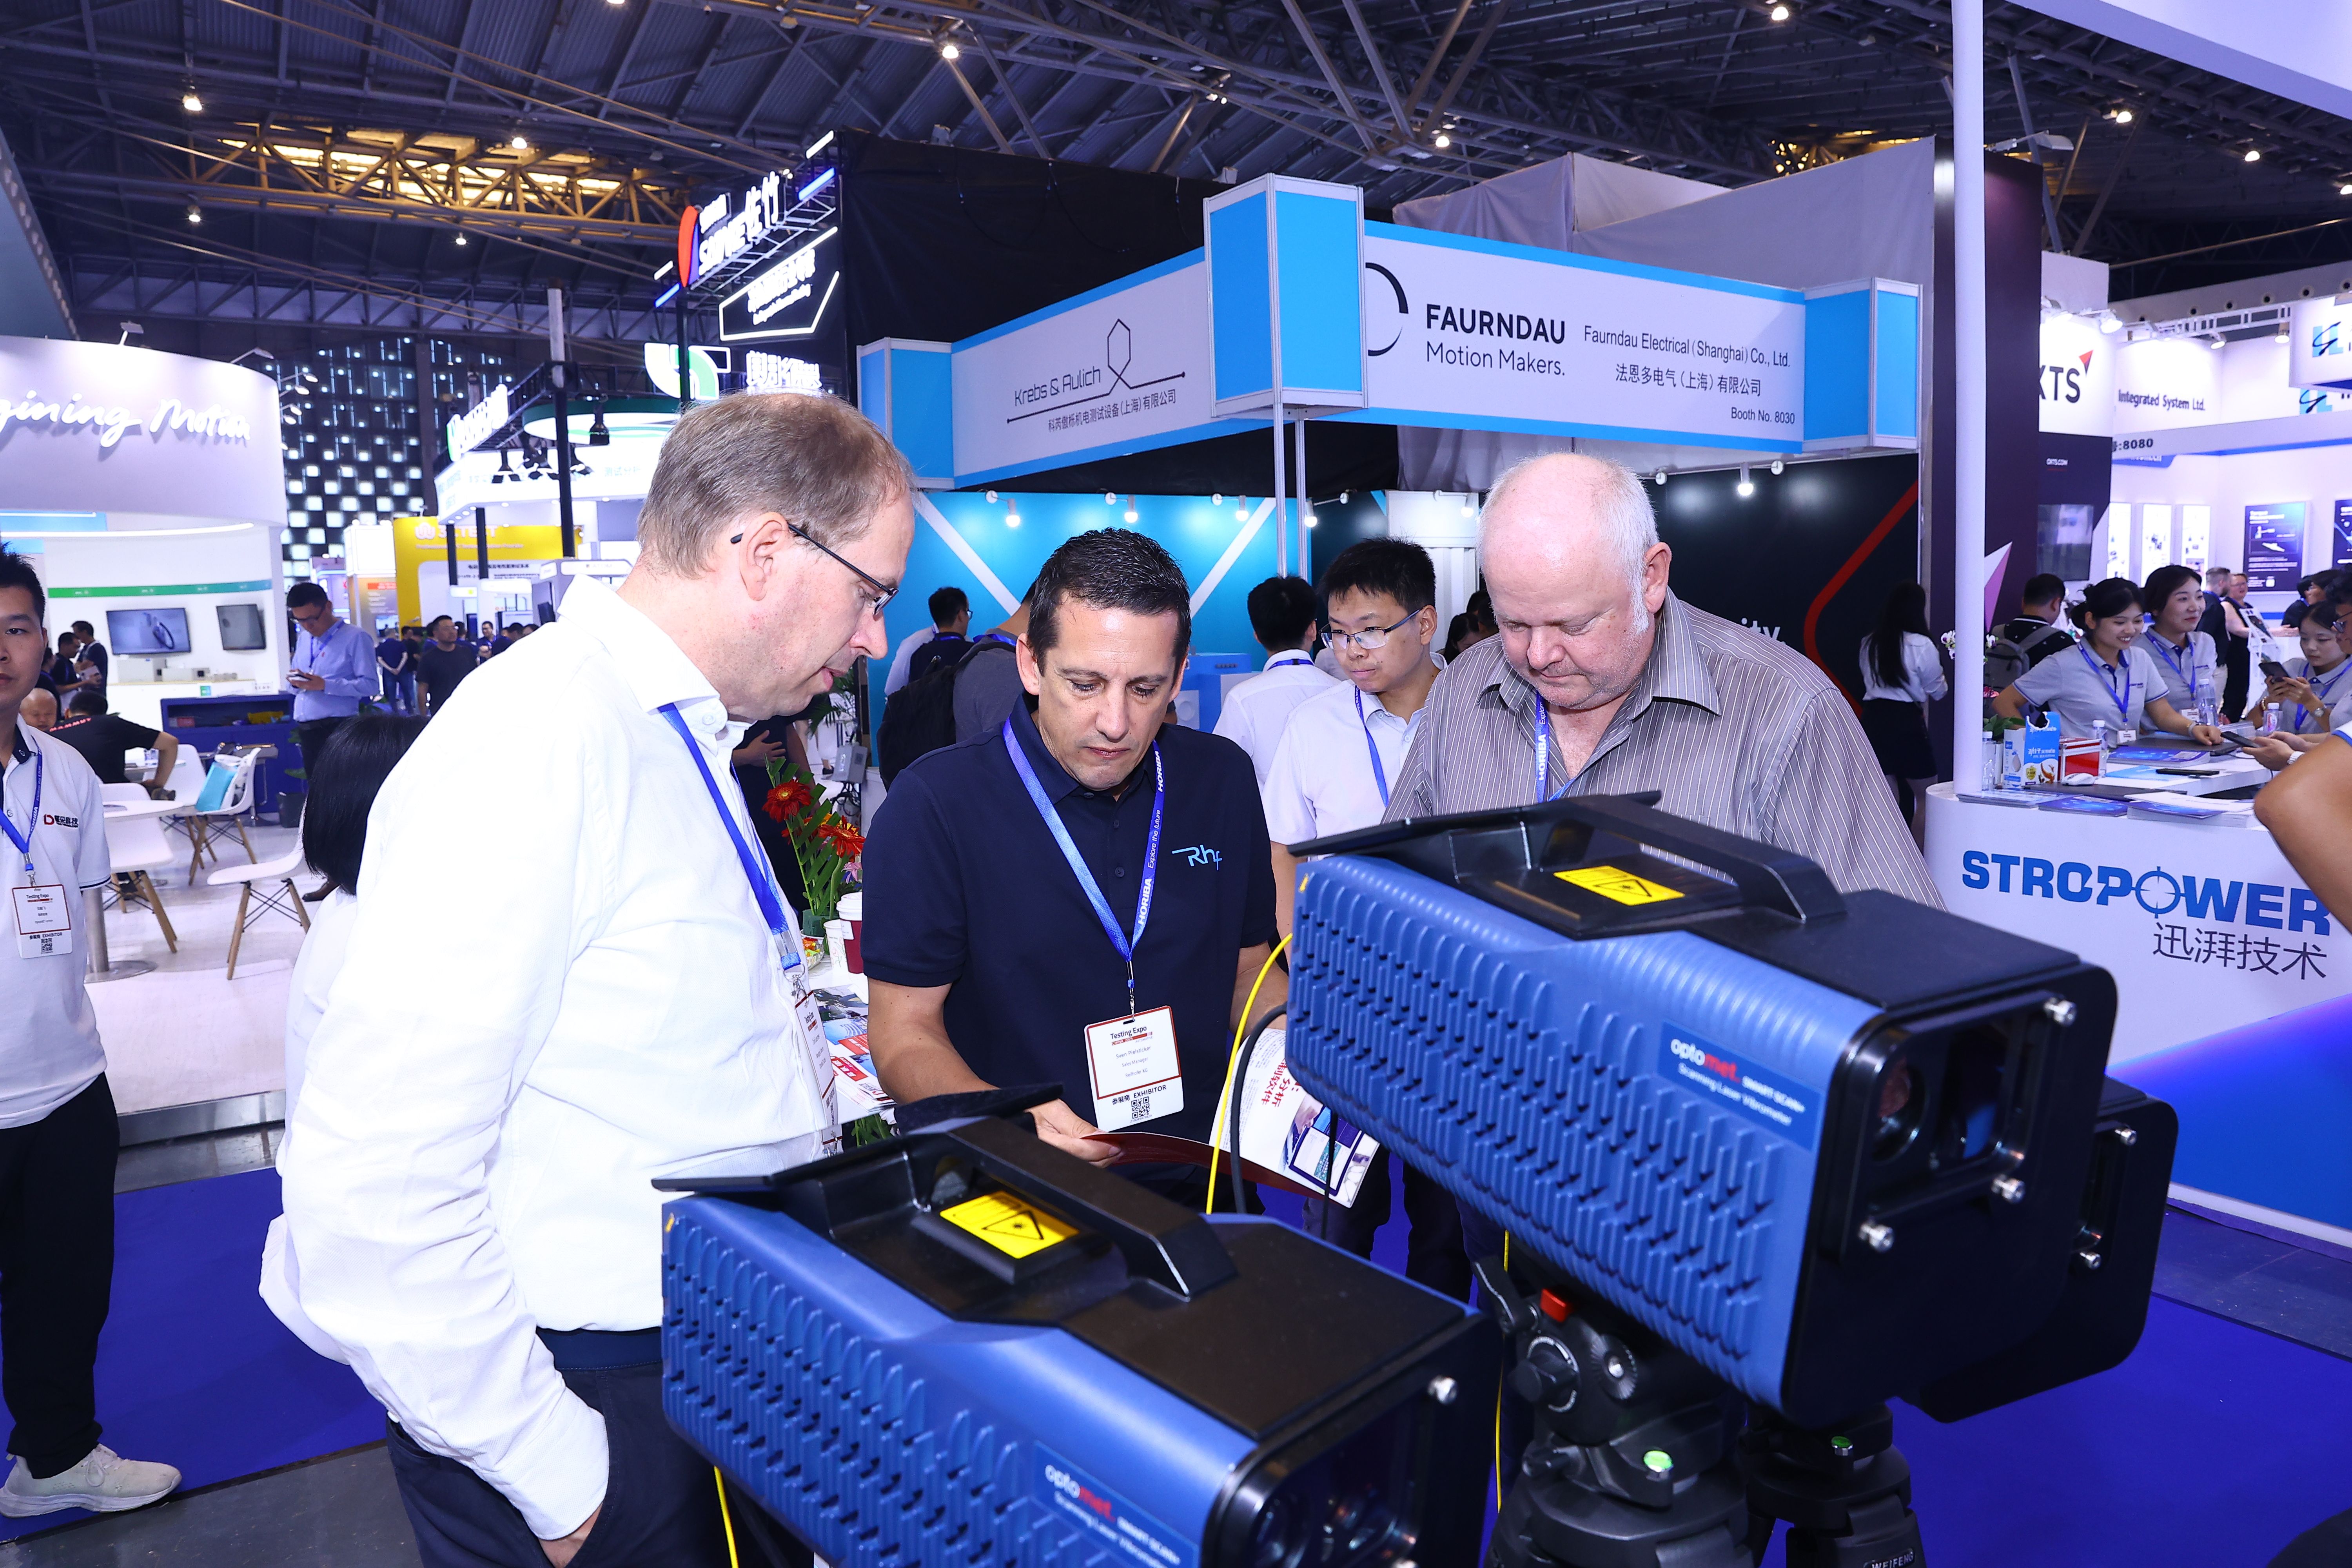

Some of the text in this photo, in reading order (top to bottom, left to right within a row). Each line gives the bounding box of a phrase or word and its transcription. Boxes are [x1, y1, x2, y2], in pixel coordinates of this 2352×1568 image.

[1426, 303, 1565, 345] FAURNDAU
[1426, 340, 1565, 376] Motion Makers.
[1584, 325, 1638, 348] Faurndau
[1642, 332, 1690, 354] Electrical
[1750, 348, 1769, 366] Co.,
[1773, 351, 1791, 368] Ltd.
[1014, 366, 1101, 407] Krebs & Aulich
[1615, 363, 1761, 397] 法恩多电气（上海）有限公司
[1731, 407, 1795, 425] Booth No. 8030
[2118, 388, 2205, 412] Integrated System Ltd.
[149, 398, 251, 441] Motion
[438, 525, 499, 538] 3TET
[1538, 734, 1547, 781] HORIBA
[1138, 878, 1152, 925] HORIBA
[1147, 842, 1157, 869] Explore
[1154, 750, 1163, 793] HORIBA
[2153, 922, 2327, 981] 迅湃技术
[1110, 1025, 1147, 1040] Testing Expo
[1128, 1046, 1151, 1056] Pielsticker
[1132, 1057, 1148, 1065] Manager
[1112, 1085, 1167, 1105] 参展商 EXHIBITOR
[1261, 1057, 1288, 1106] 制软件
[1272, 1077, 1290, 1108] 分析
[1871, 1552, 1914, 1568] WEIFENG
